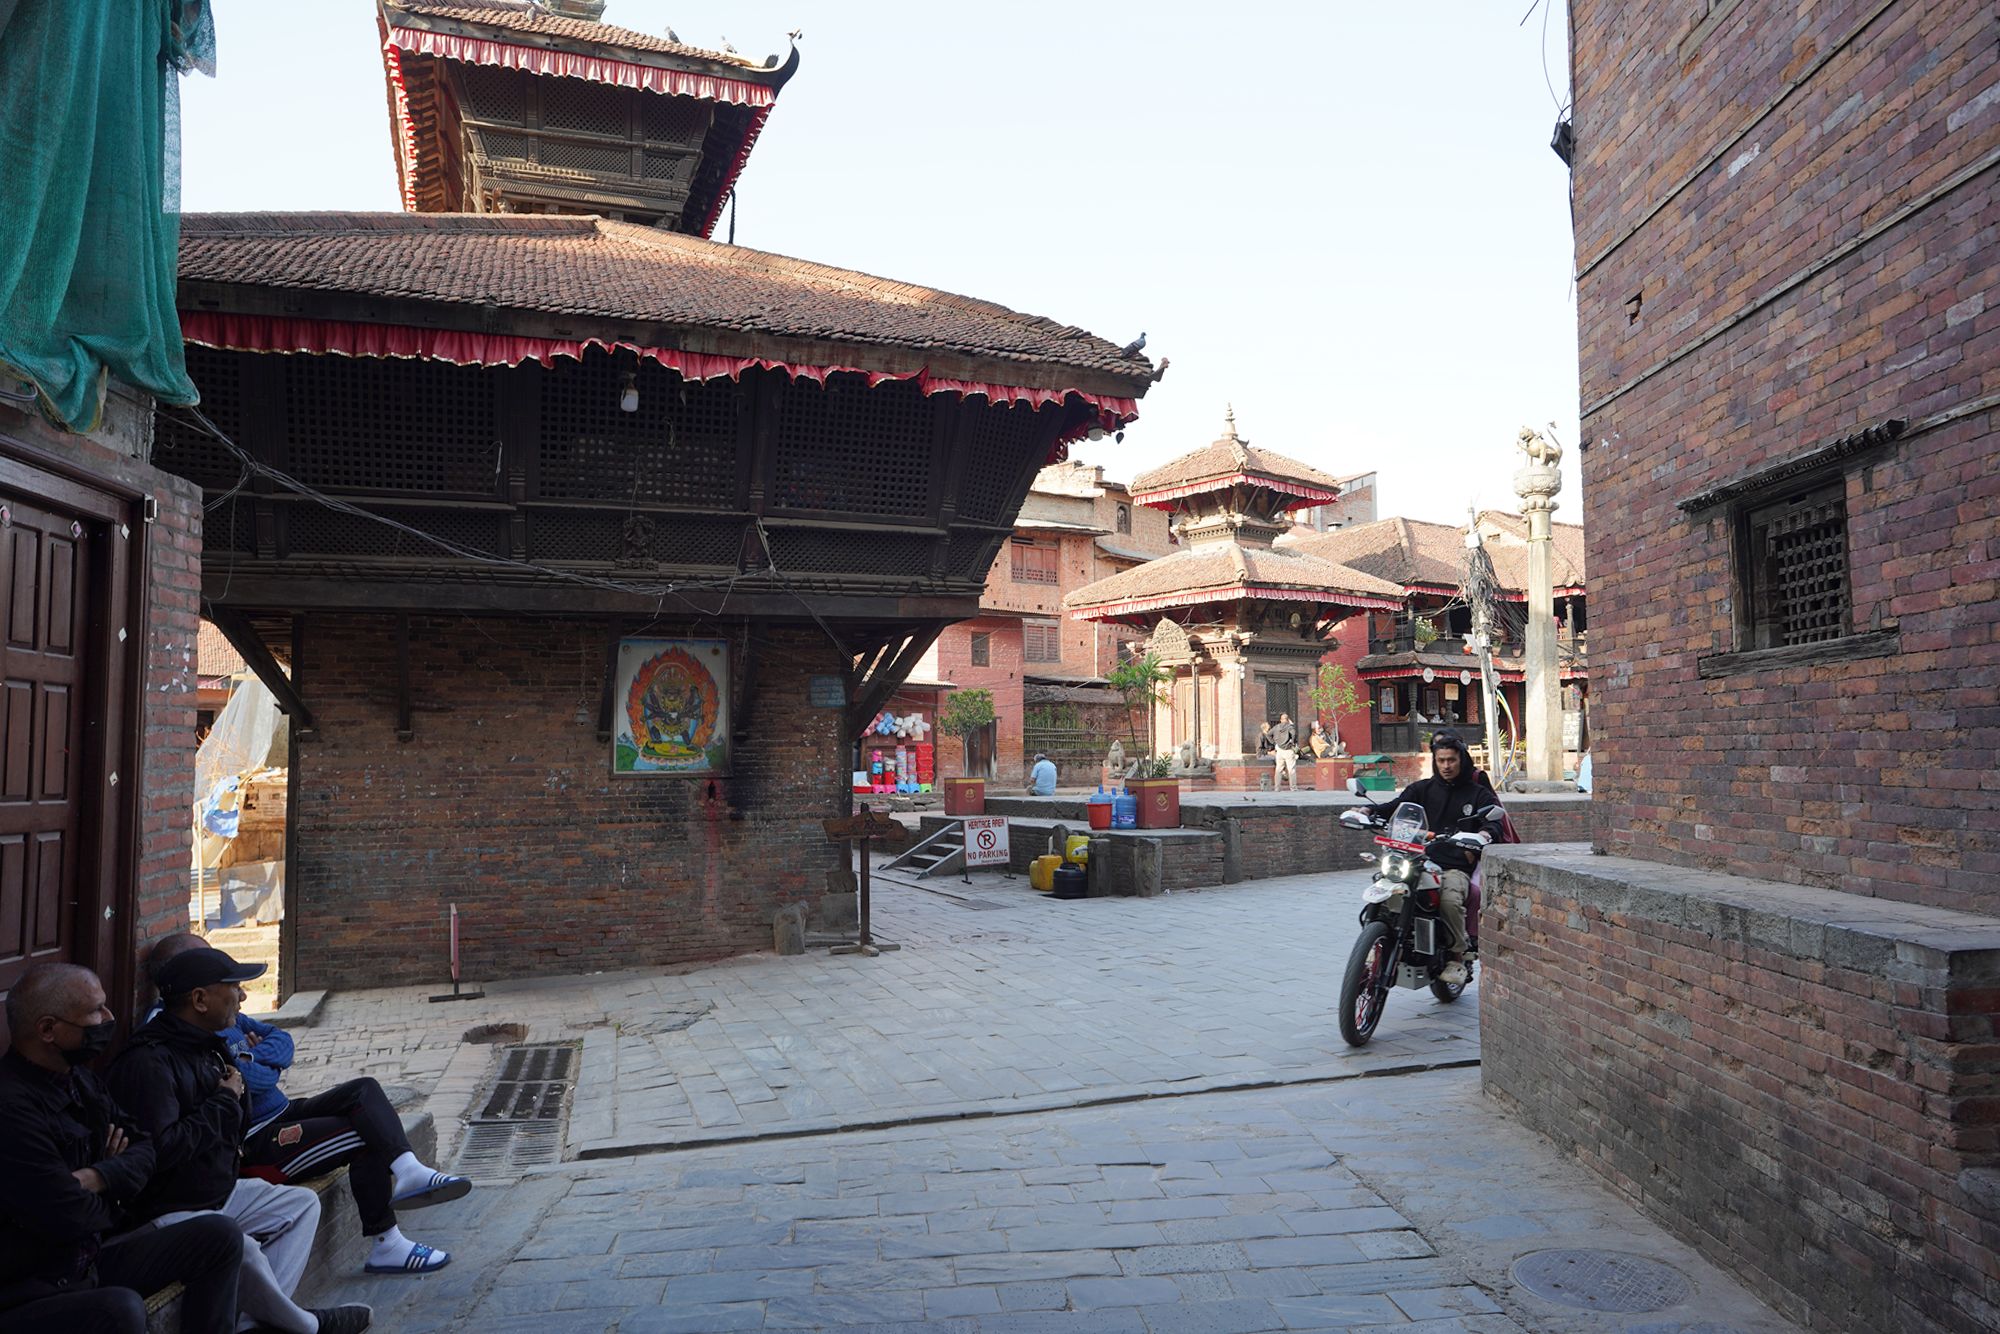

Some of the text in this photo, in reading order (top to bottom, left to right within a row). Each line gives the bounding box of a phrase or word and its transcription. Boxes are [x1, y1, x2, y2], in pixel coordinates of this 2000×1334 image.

[968, 818, 1004, 830] HERITAGE AREA
[968, 850, 1008, 860] NO PARKING
